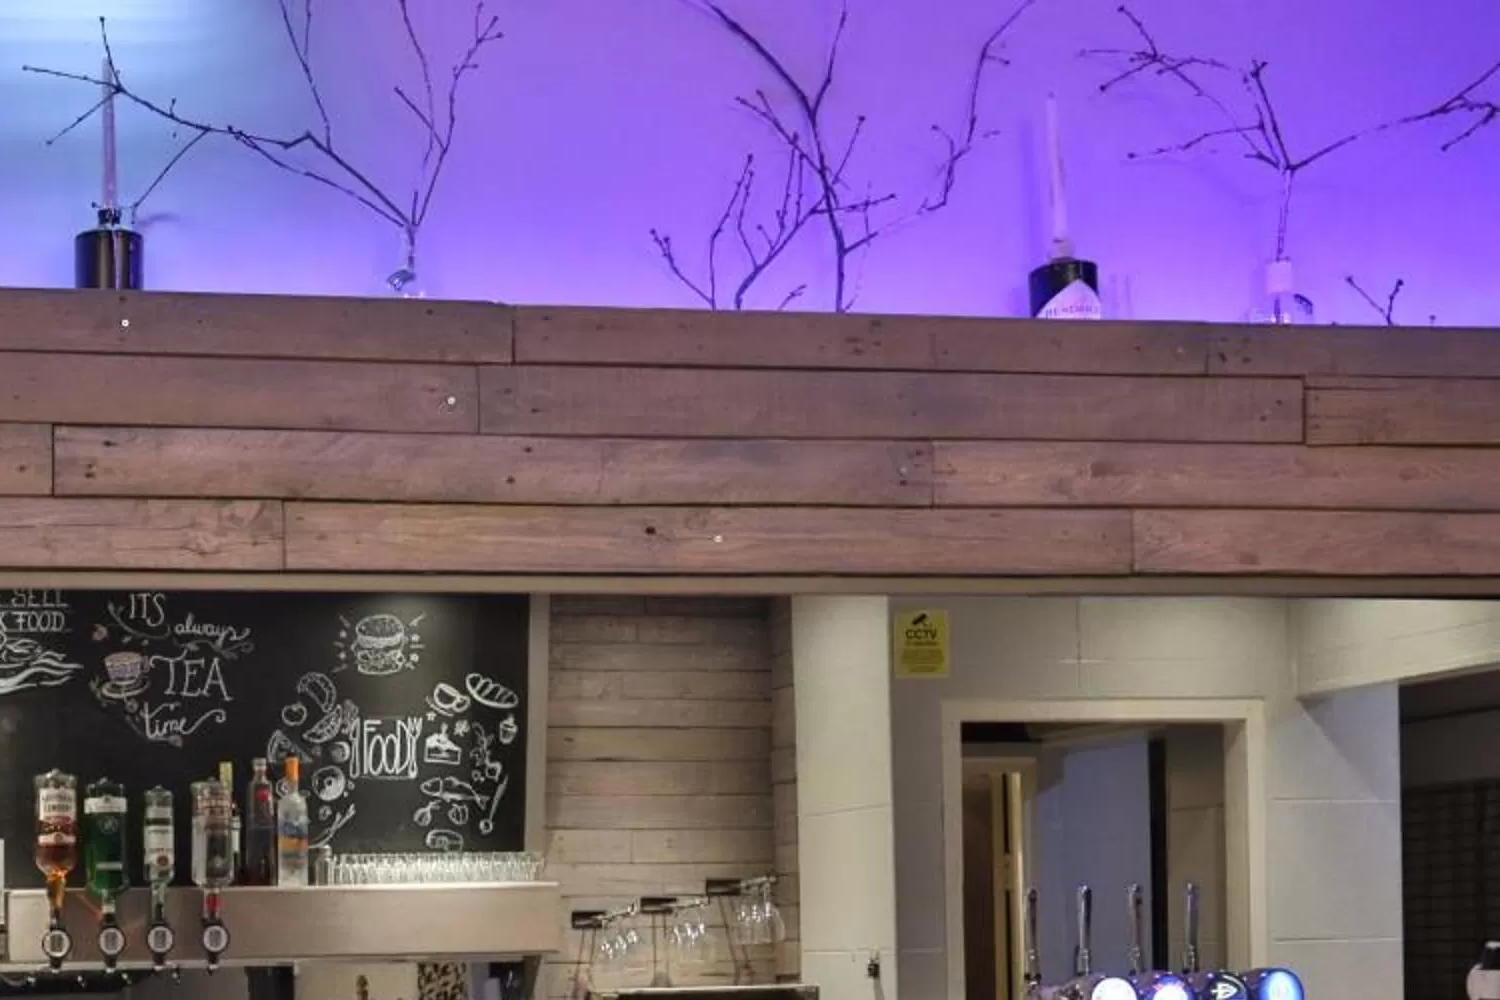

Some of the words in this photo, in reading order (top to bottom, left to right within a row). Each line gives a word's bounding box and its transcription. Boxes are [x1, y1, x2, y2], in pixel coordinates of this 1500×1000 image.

[11, 610, 65, 632] FOOD
[174, 612, 251, 650] always
[150, 649, 233, 701] TEA
